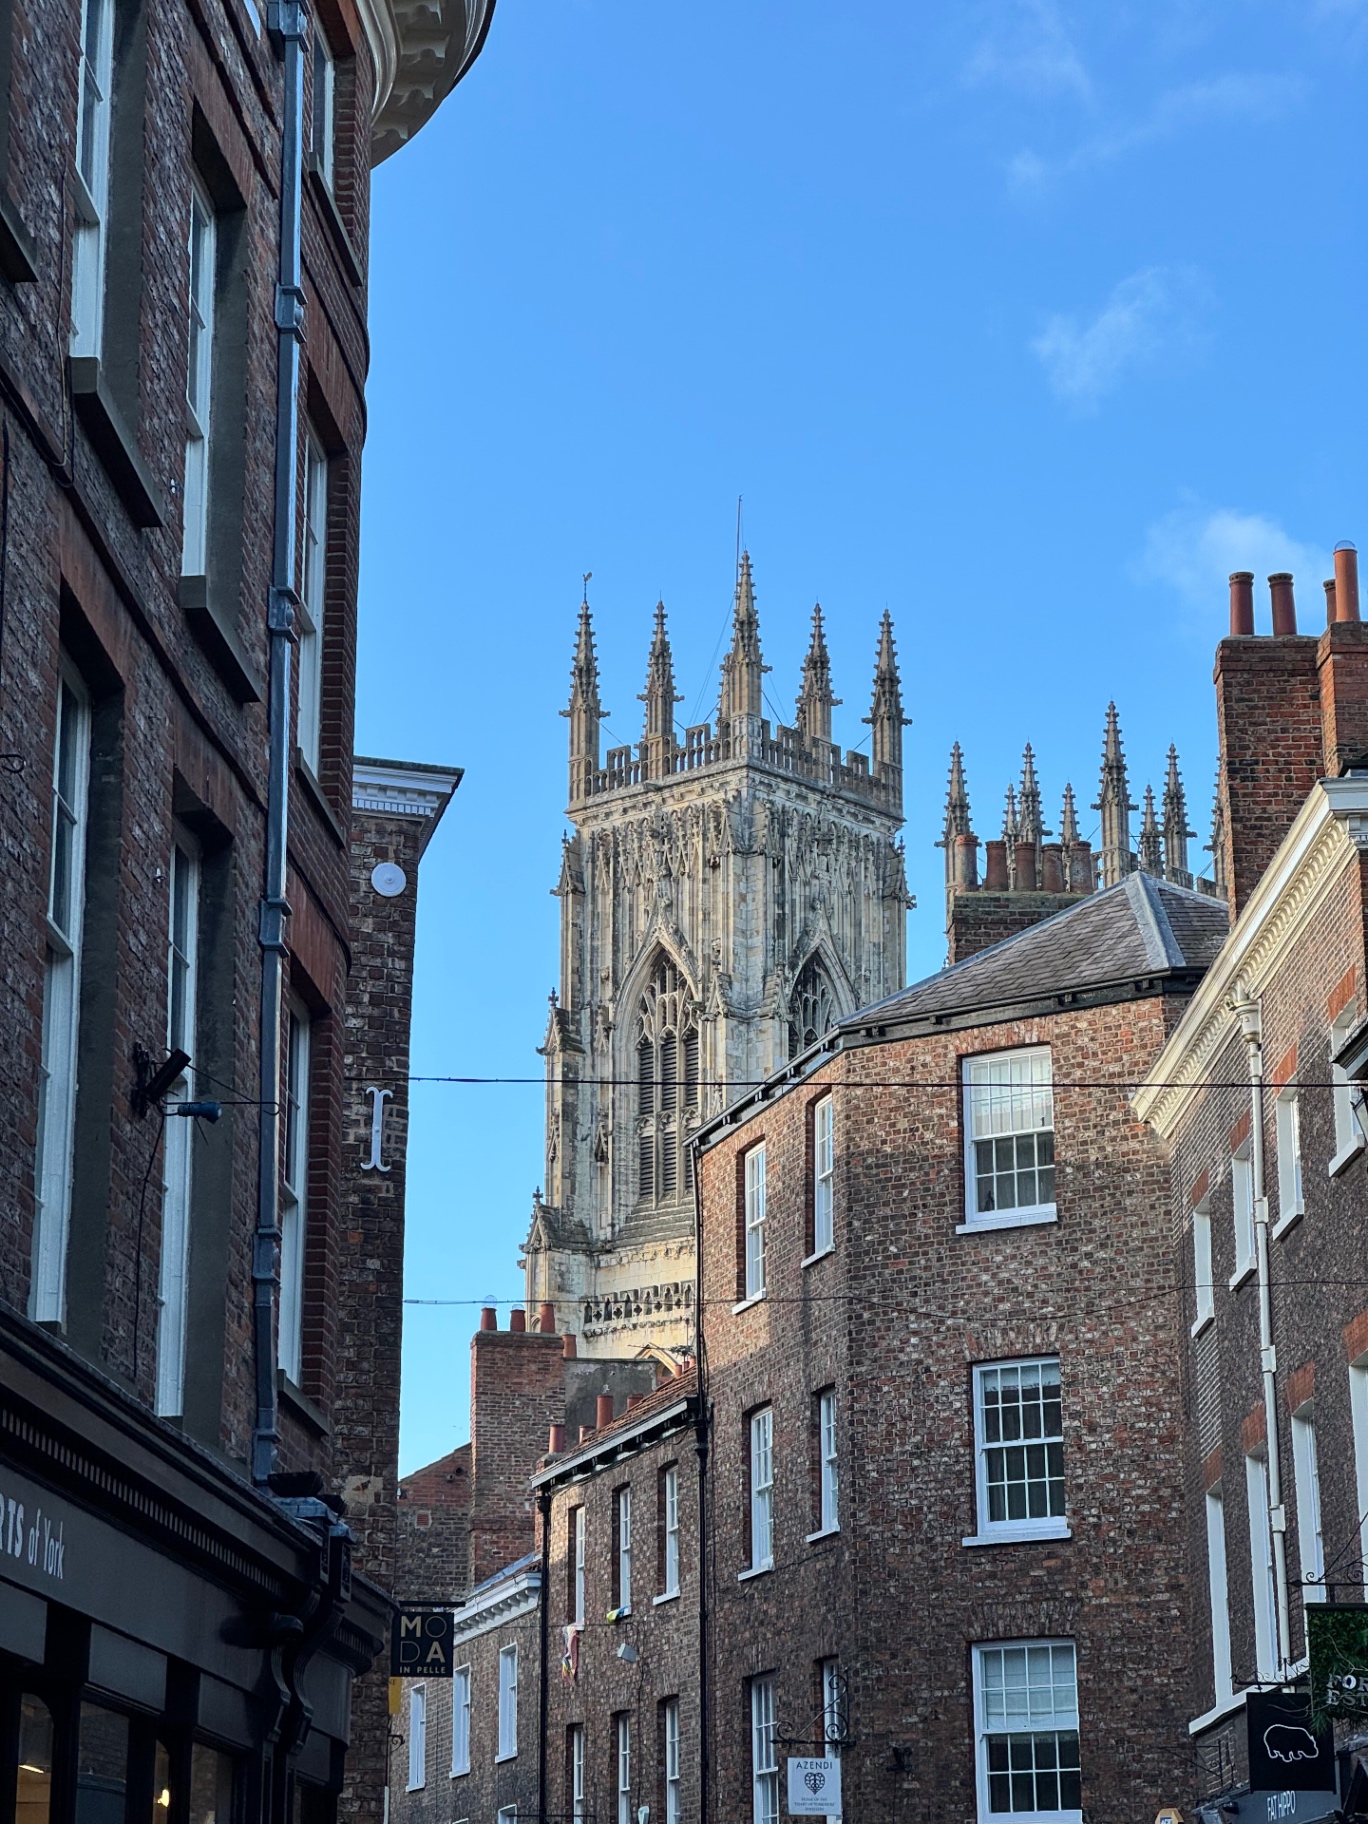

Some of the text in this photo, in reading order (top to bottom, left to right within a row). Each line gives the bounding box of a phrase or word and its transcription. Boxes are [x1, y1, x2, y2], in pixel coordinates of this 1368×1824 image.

[28, 1508, 41, 1566] of
[43, 1517, 65, 1580] York
[399, 1666, 446, 1674] IN PELLE
[796, 1760, 833, 1770] AZENDI
[1266, 1790, 1296, 1822] FAT HIPPO
